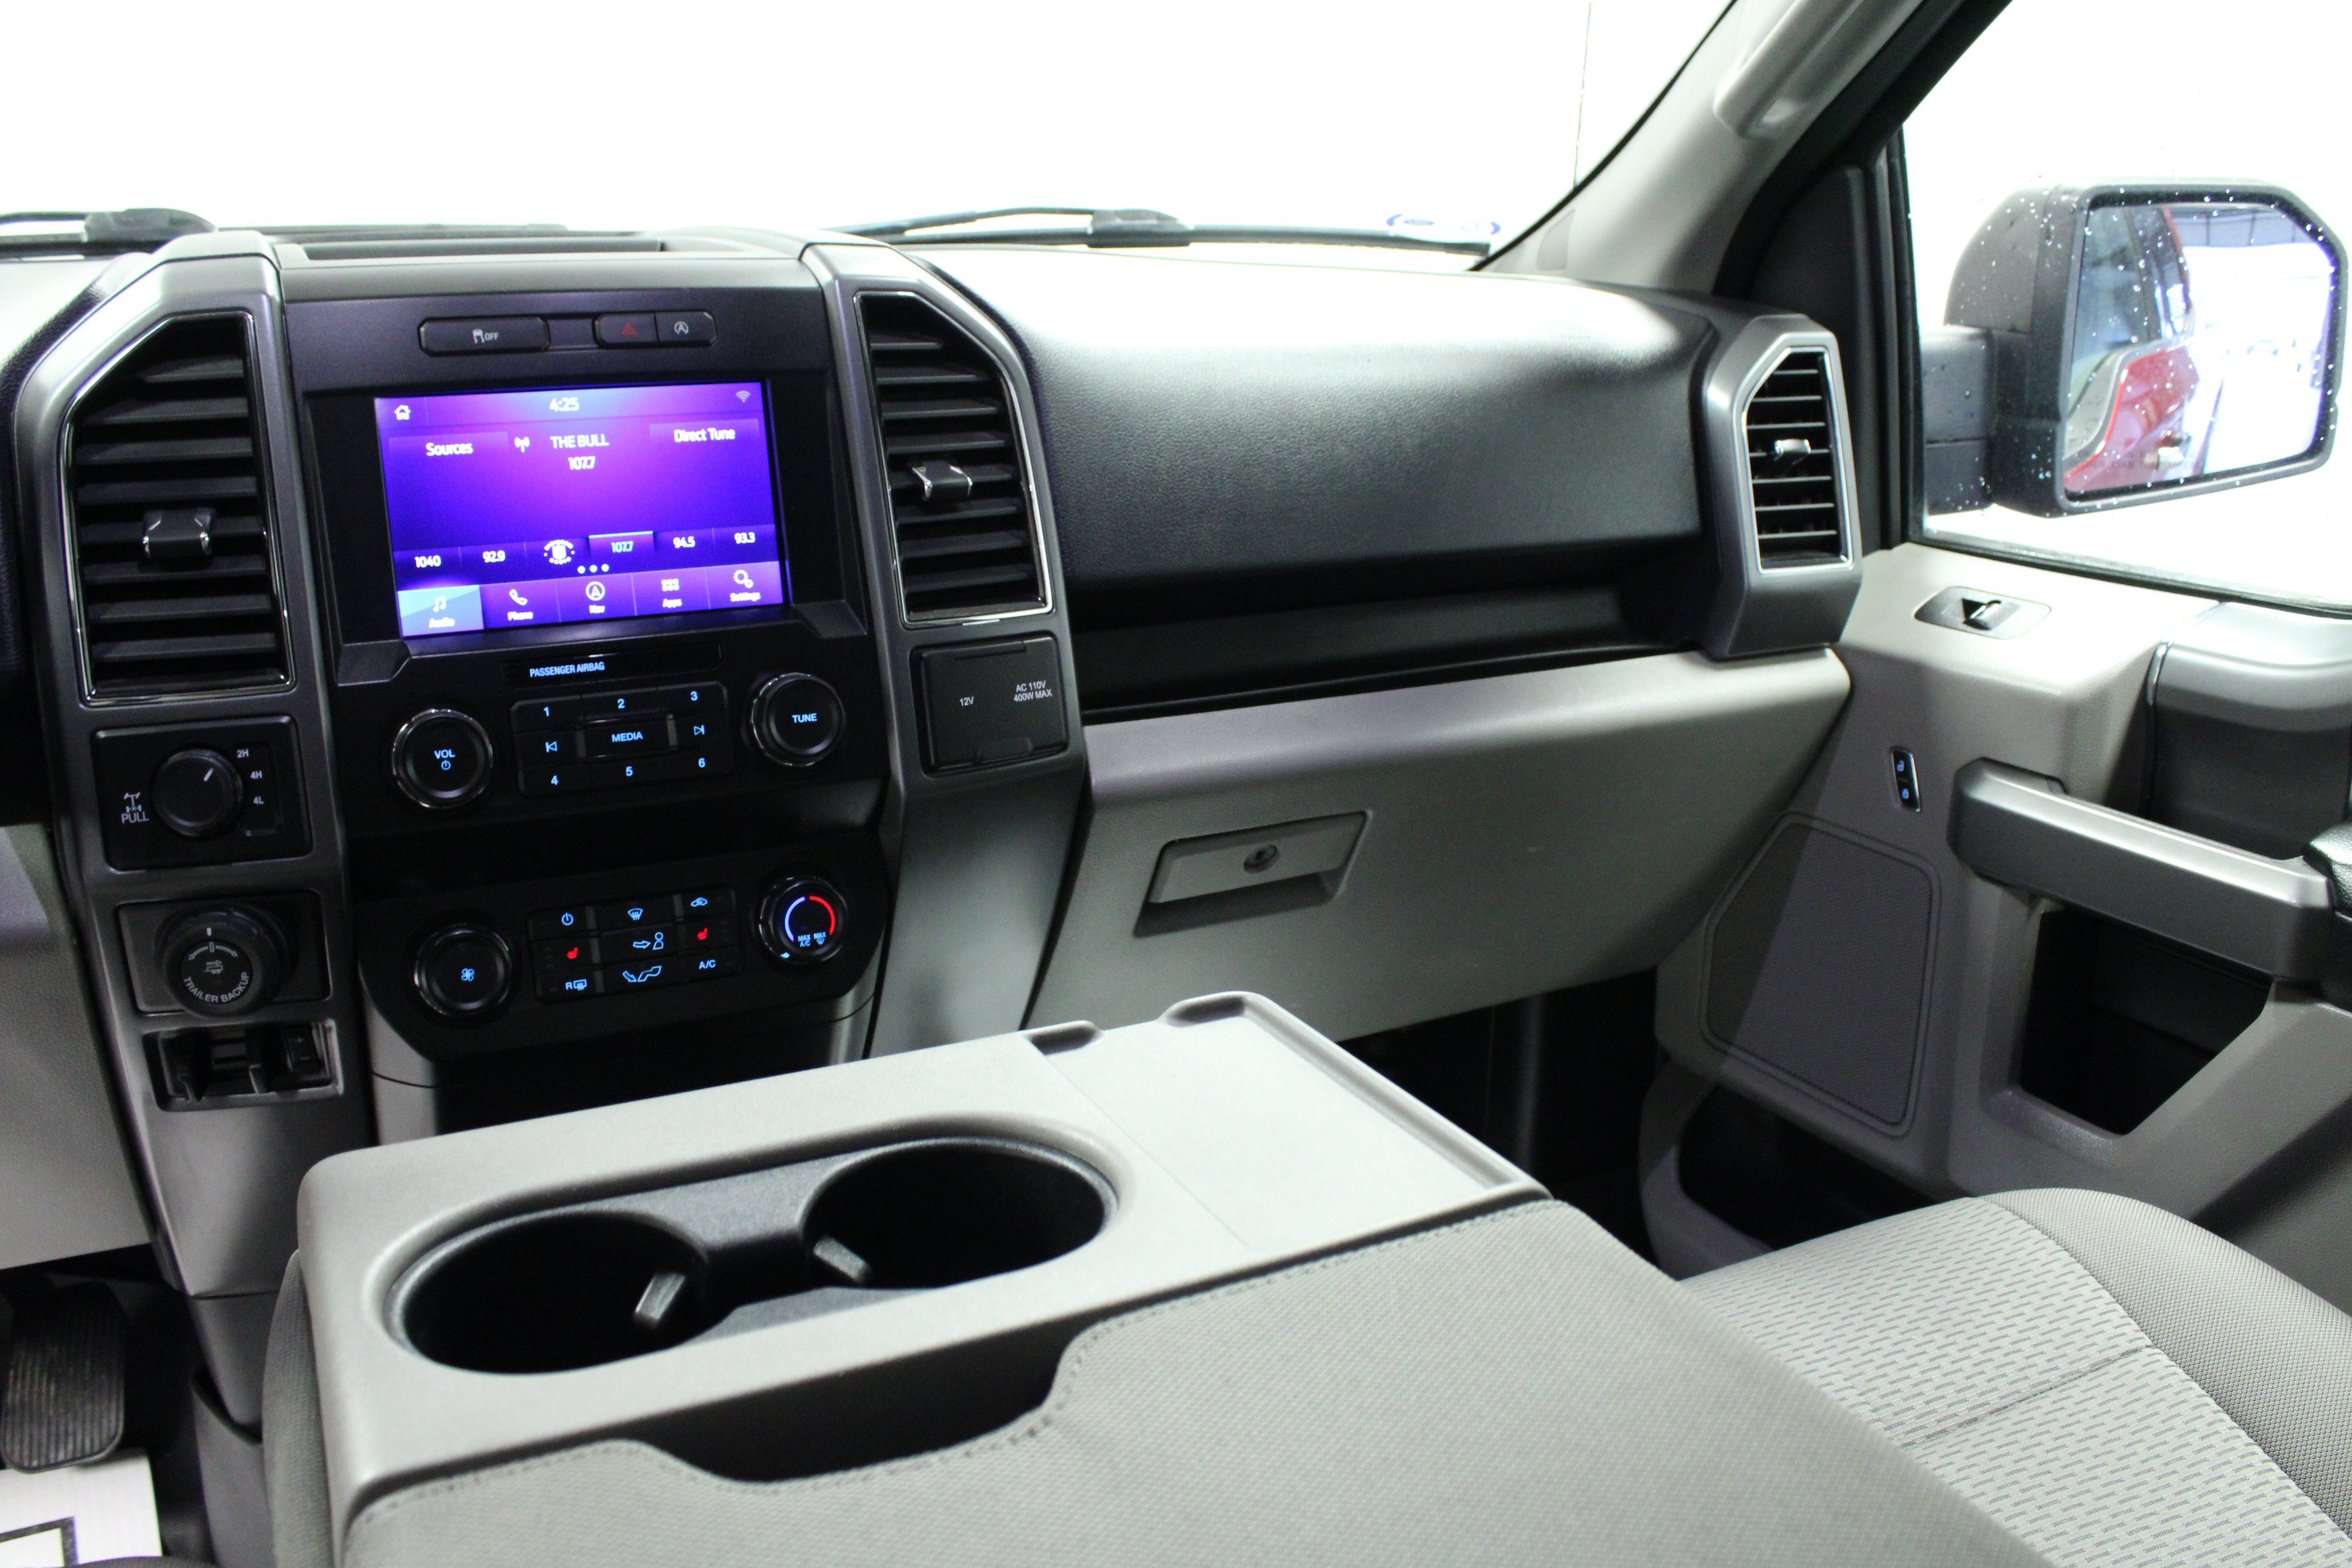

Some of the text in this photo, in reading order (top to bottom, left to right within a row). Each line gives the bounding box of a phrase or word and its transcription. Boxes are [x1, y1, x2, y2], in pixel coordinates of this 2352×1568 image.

[484, 332, 499, 341] OFF
[549, 396, 580, 412] 4:25
[674, 427, 736, 443] Direct Tune
[550, 433, 610, 449] THE BULL
[426, 442, 474, 456] Sources
[567, 455, 596, 471] 107.7
[672, 535, 696, 548] 94.5
[734, 531, 756, 544] 93.3
[610, 540, 634, 553] 107.7
[414, 555, 442, 568] 1040
[482, 550, 506, 563] 92.9
[730, 592, 762, 602] Settings
[662, 598, 683, 609] Apps
[589, 605, 606, 614] Nav
[507, 611, 534, 621] Phone
[530, 661, 606, 678] PASSENGER AIRBAG
[1016, 680, 1046, 692] AC 110V
[690, 691, 698, 701] 3
[959, 696, 974, 706] 12V
[1013, 689, 1053, 703] 400W MAX
[617, 698, 625, 709] 2
[543, 706, 550, 717] 1
[792, 713, 818, 723] TUNE
[611, 731, 644, 743] MEDIA
[237, 749, 249, 758] 2H
[434, 749, 456, 759] VOL
[698, 757, 706, 768] 6
[250, 770, 263, 779] 4H
[625, 766, 633, 777] 5
[551, 775, 559, 786] 4
[253, 796, 264, 805] 4L
[121, 812, 150, 824] PULL
[798, 934, 811, 942] MAX
[813, 931, 827, 940] MAX
[698, 959, 716, 969] A/C
[183, 971, 250, 1003] TRAILER BACKUP
